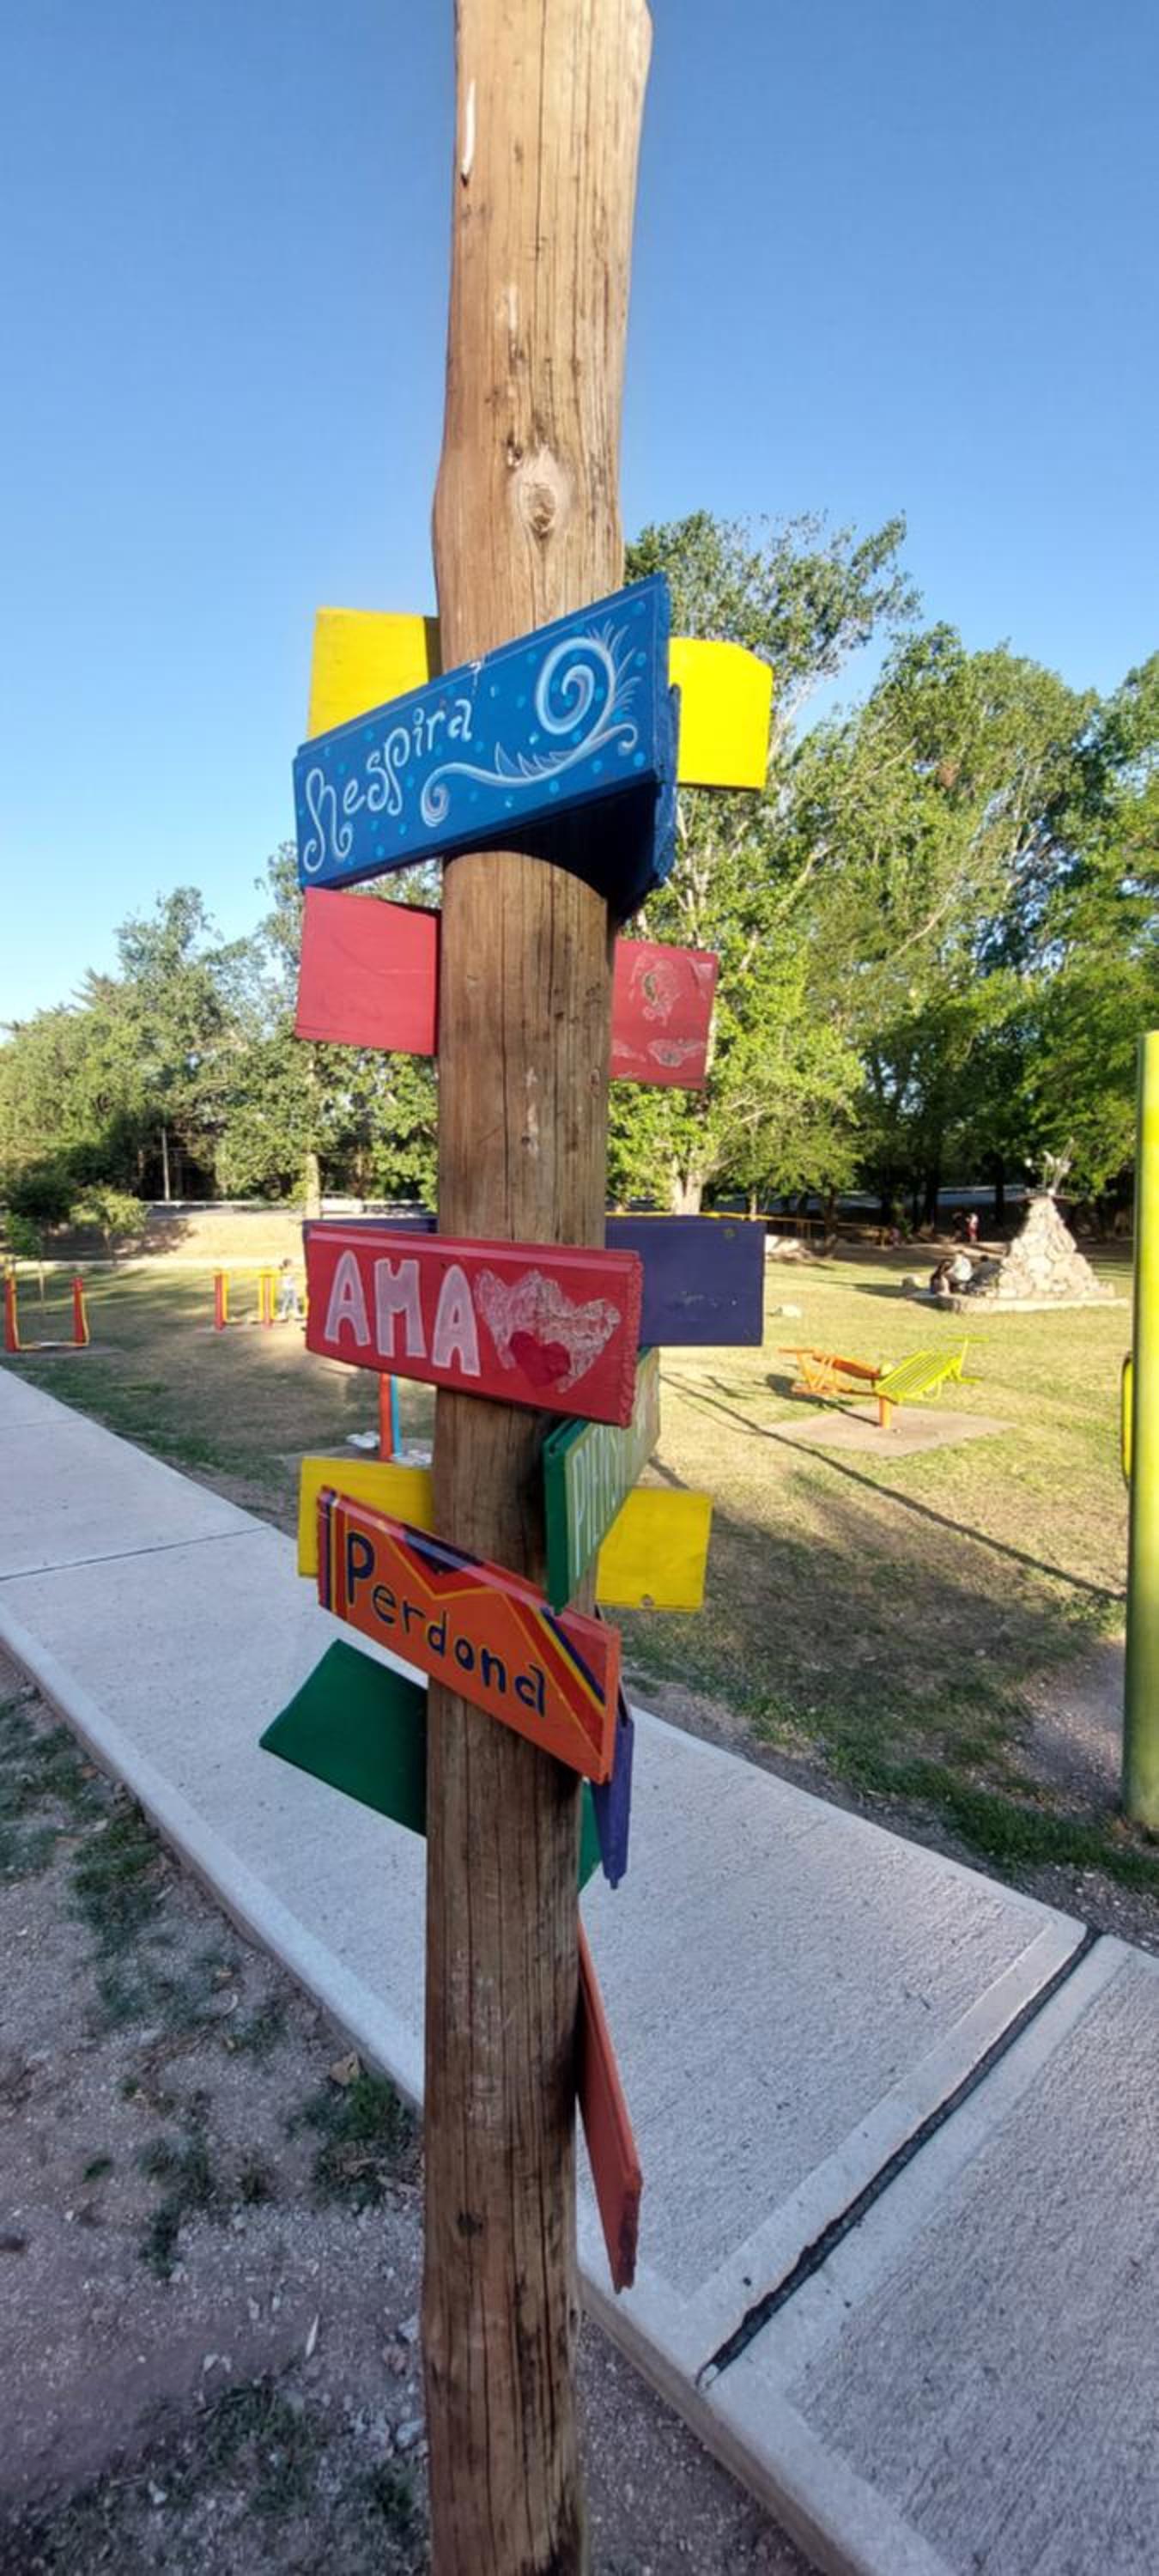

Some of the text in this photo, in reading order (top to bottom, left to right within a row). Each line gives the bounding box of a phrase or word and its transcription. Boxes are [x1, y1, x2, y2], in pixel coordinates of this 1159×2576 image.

[303, 698, 472, 872] Respira
[324, 1250, 481, 1376] AMA
[345, 1531, 547, 1718] Perdona
